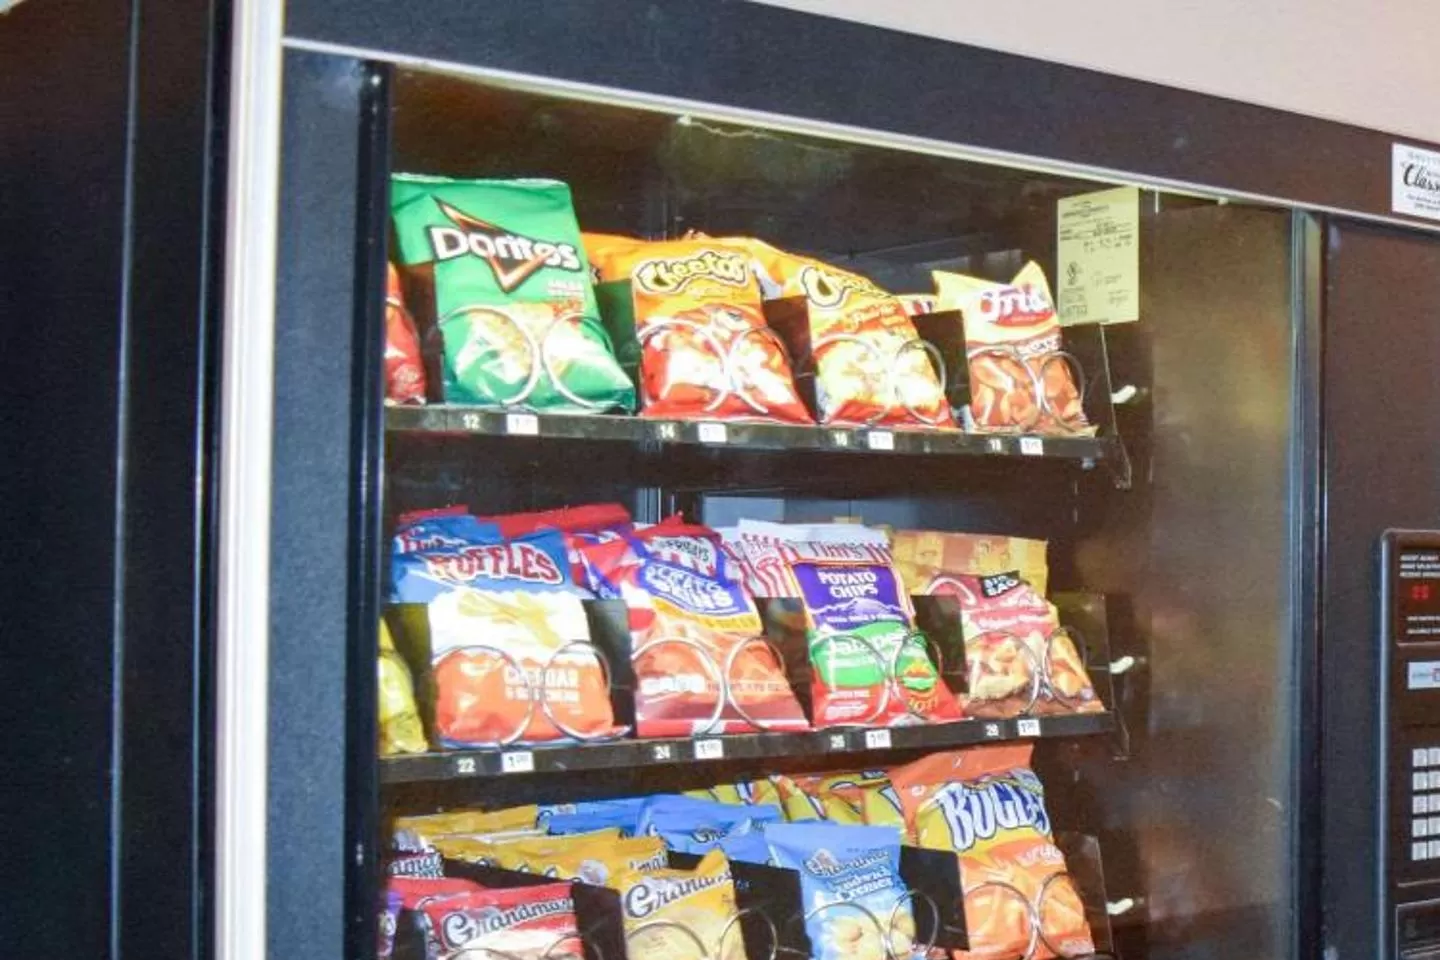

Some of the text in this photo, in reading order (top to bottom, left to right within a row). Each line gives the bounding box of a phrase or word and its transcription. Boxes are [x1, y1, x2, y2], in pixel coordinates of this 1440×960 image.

[429, 226, 580, 272] Doritos
[638, 252, 747, 290] Cheetos
[463, 414, 480, 429] 12
[660, 425, 676, 440] 14
[424, 544, 564, 583] RUFFLES
[817, 571, 878, 585] POTATO
[829, 584, 880, 599] CHIPS
[655, 746, 671, 760] 24
[457, 758, 476, 773] 22
